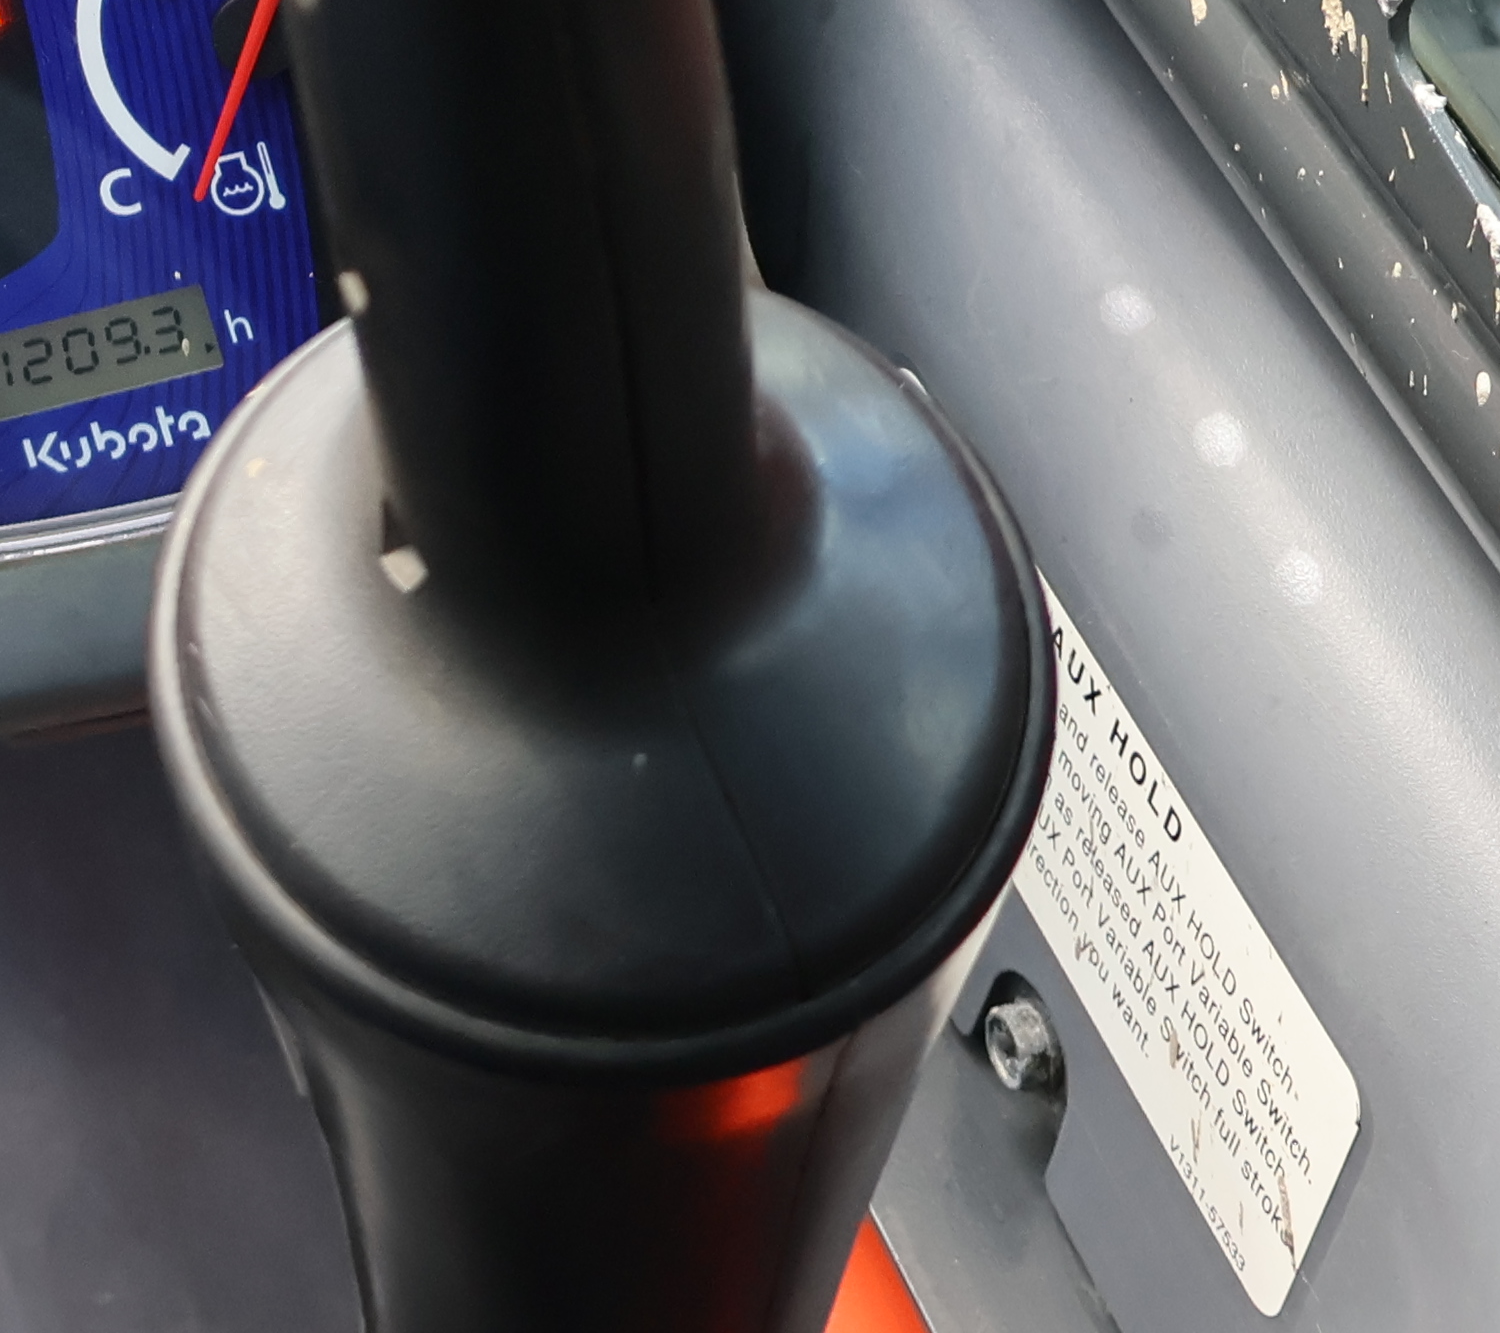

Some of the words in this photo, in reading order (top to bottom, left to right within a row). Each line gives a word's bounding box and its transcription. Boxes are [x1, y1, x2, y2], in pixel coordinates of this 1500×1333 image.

[99, 167, 142, 216] C
[1, 305, 186, 387] 1209.3
[223, 309, 254, 344] h
[22, 405, 212, 473] Kubota
[1051, 626, 1102, 716] AUX
[1109, 718, 1182, 842] HOLD
[1026, 835, 1079, 931] irection
[1078, 931, 1110, 984] you
[1112, 982, 1150, 1059] want.
[1054, 792, 1074, 826] as
[1076, 827, 1142, 938] released
[1142, 941, 1180, 1003] AUX
[1180, 1000, 1230, 1087] HOLD
[1058, 703, 1089, 752] and
[1090, 754, 1146, 849] release
[1148, 850, 1187, 914] AUX
[1187, 909, 1238, 996] HOLD
[1037, 803, 1061, 852] UX
[1062, 847, 1095, 909] Port
[1098, 902, 1157, 1017] Variable
[1213, 1108, 1242, 1158] full
[1058, 750, 1112, 844] moving
[1114, 844, 1153, 906] AUX
[1152, 901, 1187, 965] Port
[1190, 960, 1253, 1078] Variable
[1257, 1078, 1312, 1184] Switch.
